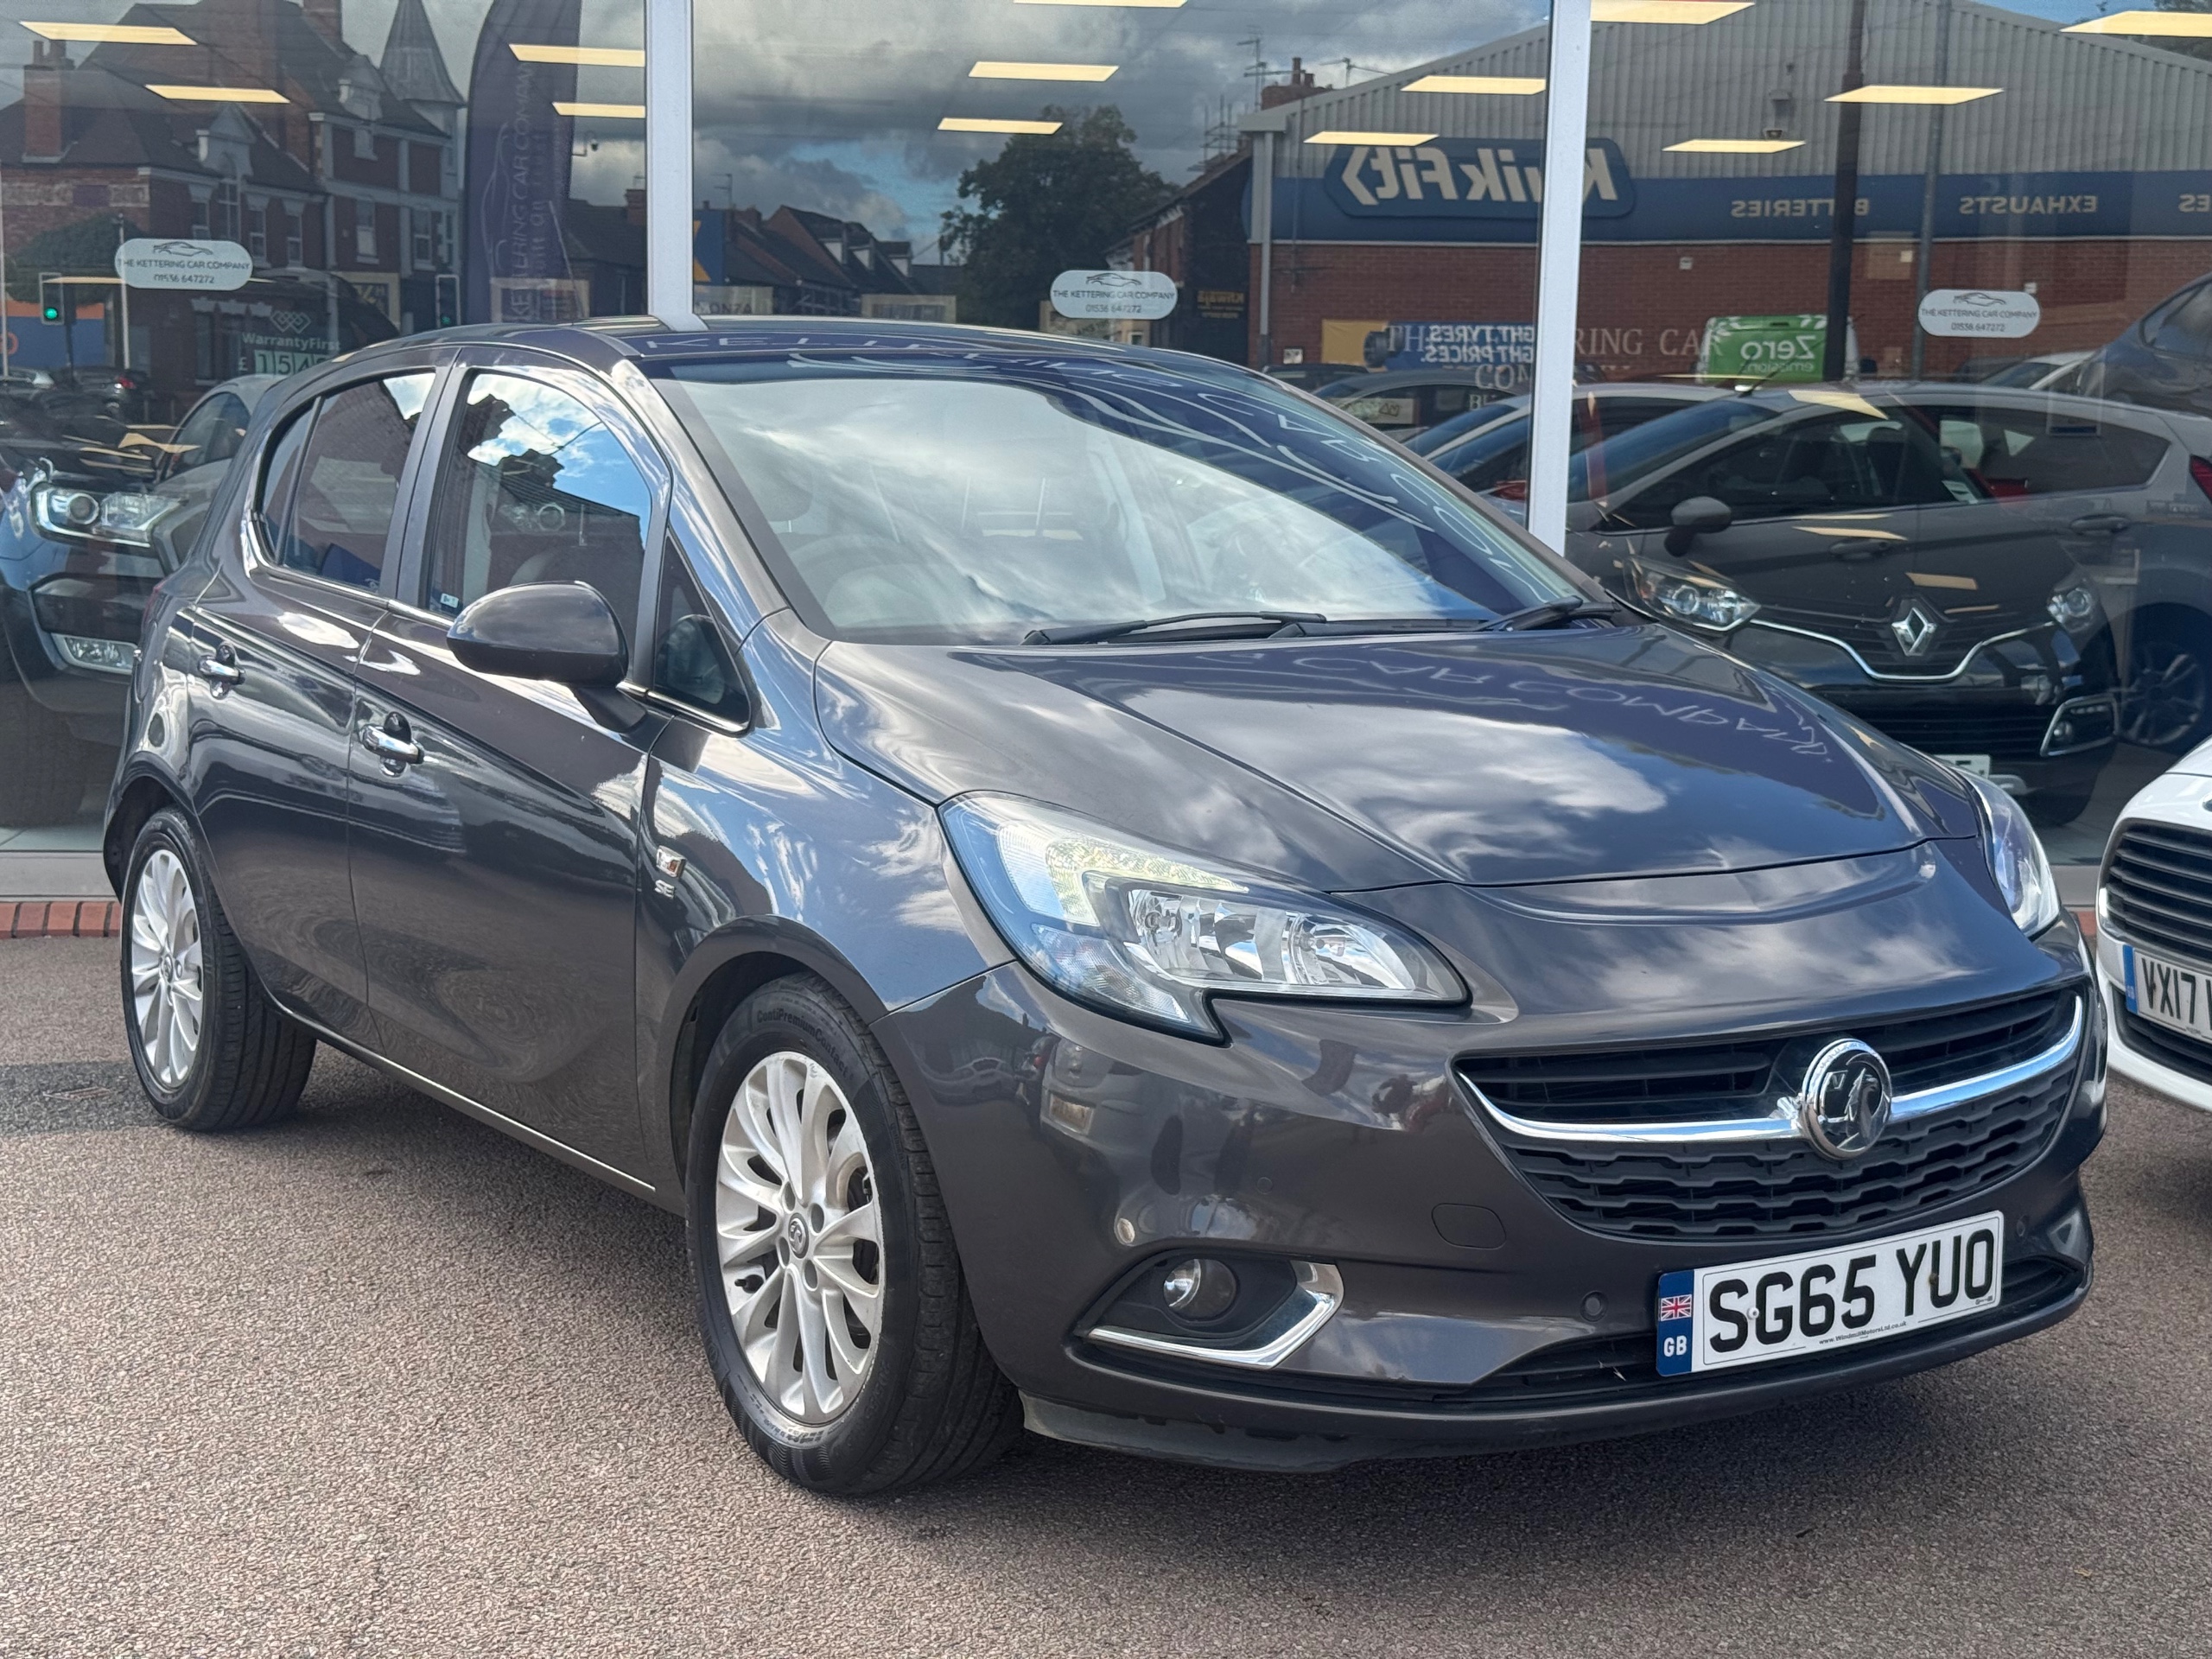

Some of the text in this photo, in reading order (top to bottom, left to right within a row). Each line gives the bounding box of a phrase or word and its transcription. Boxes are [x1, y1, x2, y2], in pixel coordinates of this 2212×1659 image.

[136, 260, 185, 269] KETTERING
[187, 261, 206, 270] CAR
[207, 261, 250, 270] COMPANY
[181, 275, 215, 284] 647272
[1071, 290, 1115, 299] KETTERING
[1116, 290, 1134, 299] CAR
[1135, 291, 1175, 300] COMPANY
[1085, 304, 1142, 314] 01536 647272
[1921, 308, 2037, 319] THE KETTERING CAR COMPANY
[1975, 323, 2005, 332] 647272
[242, 333, 340, 351] WarrantyFirst
[2140, 957, 2197, 1025] VX17
[1708, 1228, 1995, 1353] SG65 YUO
[1662, 1335, 1688, 1357] GB
